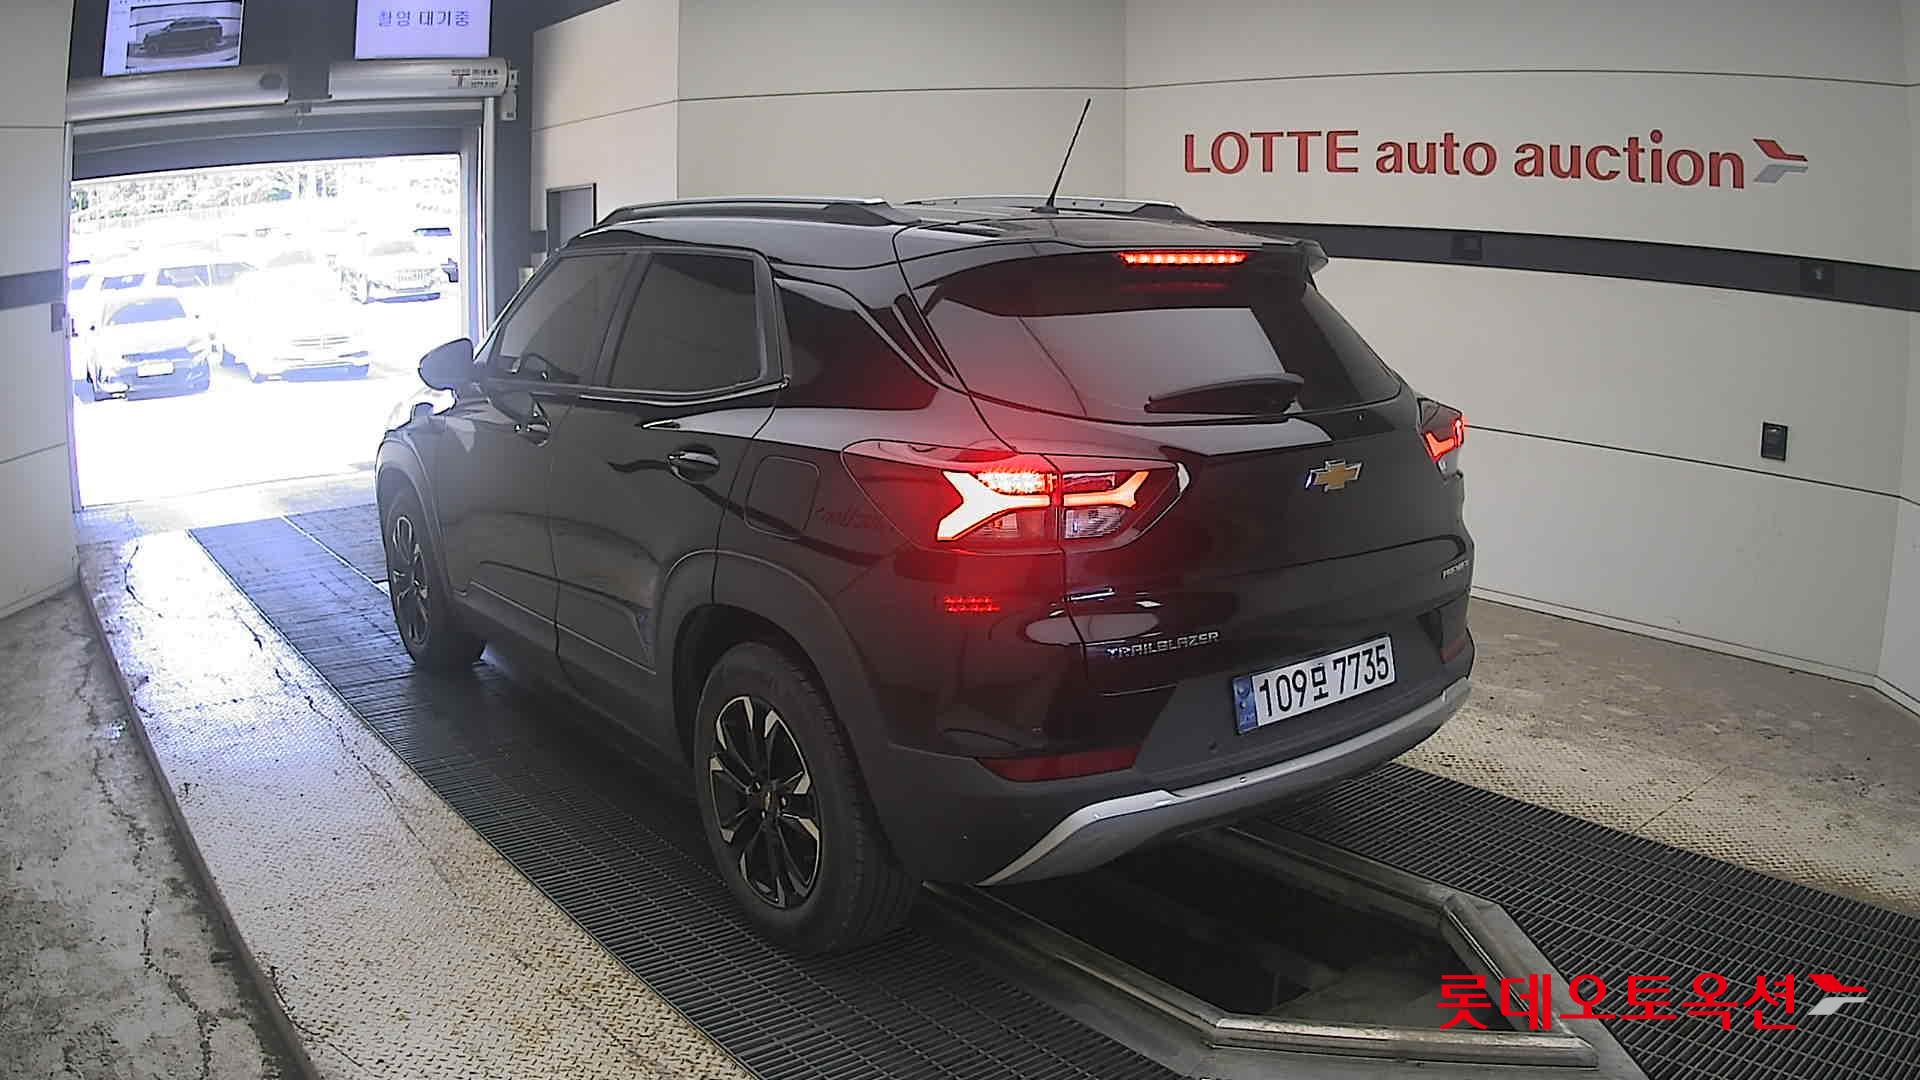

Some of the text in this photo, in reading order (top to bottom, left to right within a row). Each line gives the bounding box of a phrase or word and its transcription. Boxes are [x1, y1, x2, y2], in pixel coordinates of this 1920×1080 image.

[419, 10, 470, 28] 대기중
[1184, 129, 1745, 190] LOTTE auto auction
[1106, 631, 1219, 657] TRAILBLAZER
[1333, 644, 1390, 695] 7735
